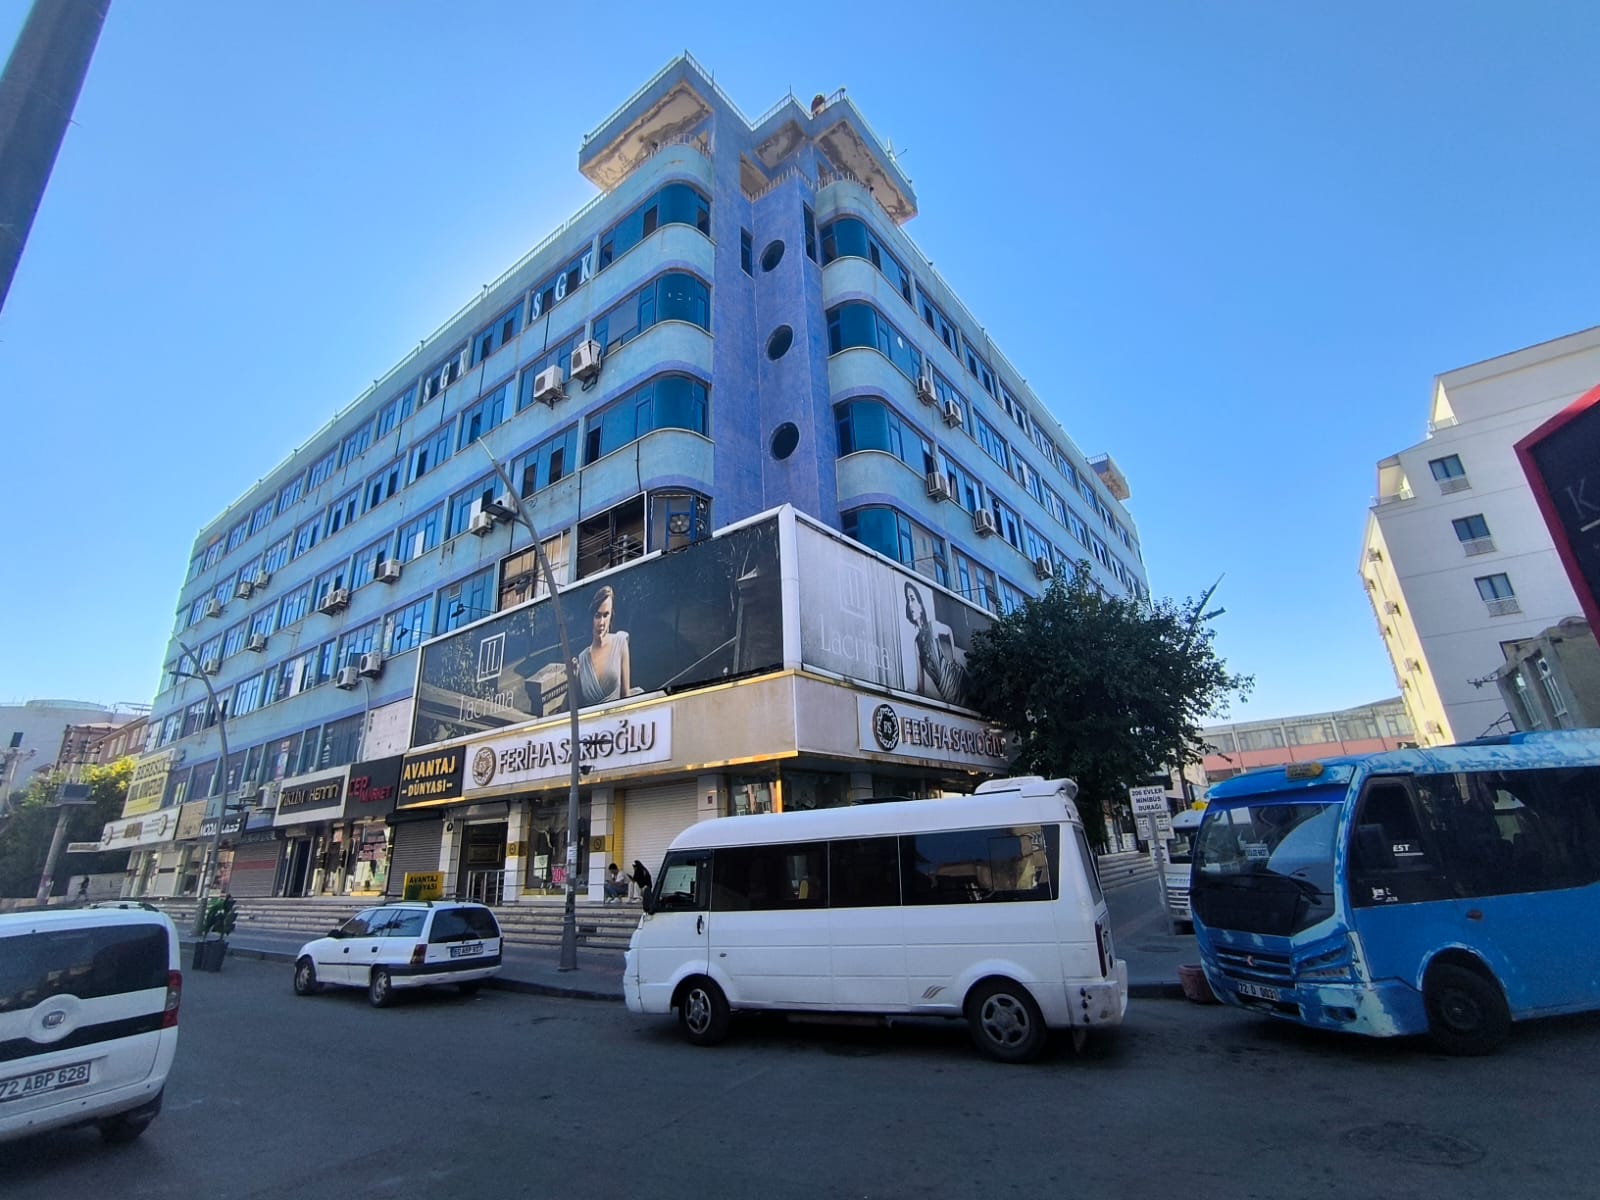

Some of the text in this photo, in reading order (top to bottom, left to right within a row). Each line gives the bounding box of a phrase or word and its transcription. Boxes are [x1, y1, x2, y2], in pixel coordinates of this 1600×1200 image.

[901, 716, 950, 749] FERİHA
[403, 756, 456, 781] AVANTAJ
[499, 739, 556, 774] FERİHA
[409, 874, 439, 885] AVANTAJ
[22, 1072, 55, 1092] ABP
[58, 1066, 86, 1084] 628
